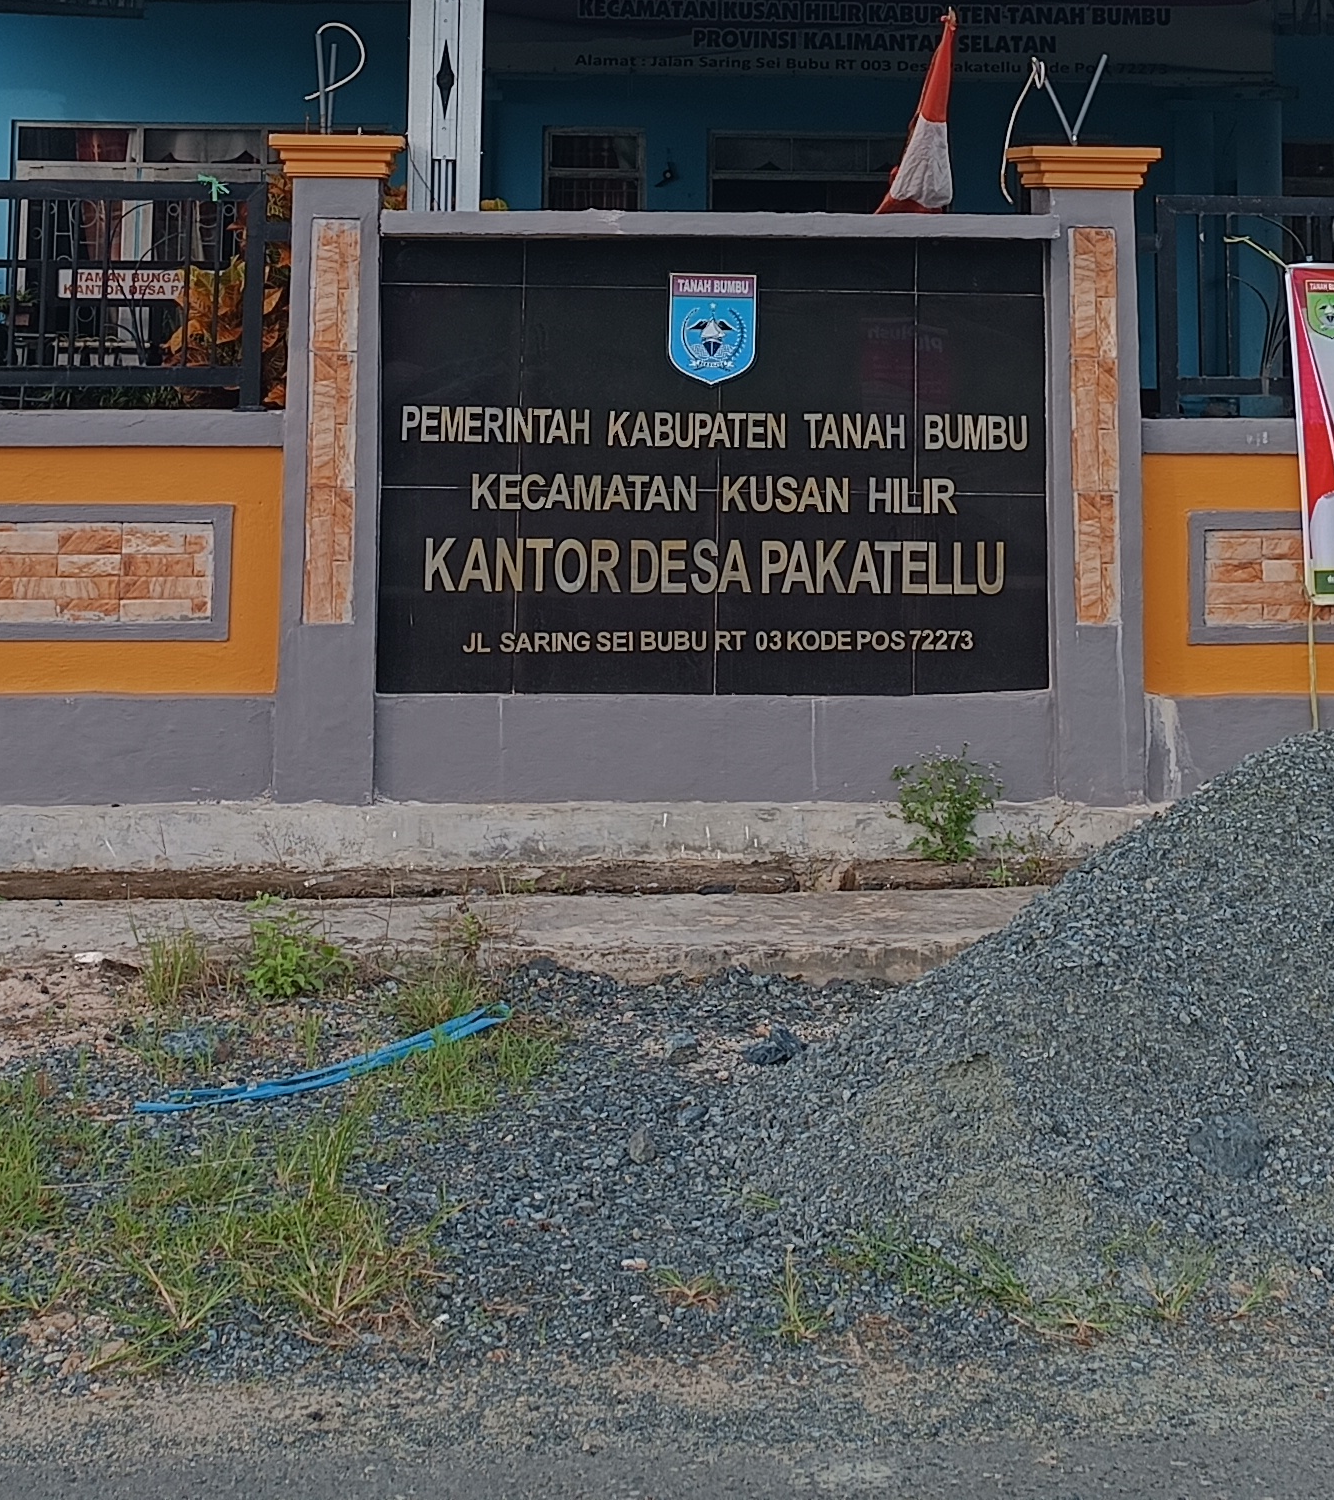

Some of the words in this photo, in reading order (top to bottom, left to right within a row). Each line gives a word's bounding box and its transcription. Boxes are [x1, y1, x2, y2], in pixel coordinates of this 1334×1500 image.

[721, 0, 803, 22] KUSAN
[803, 2, 865, 24] HILIR
[1008, 4, 1090, 25] TANAH
[1092, 5, 1172, 26] BUMBU
[691, 28, 798, 50] PROVINSI
[958, 34, 1057, 54] SELATAN
[575, 54, 637, 69] Alamat
[650, 55, 694, 69] Jalan
[698, 56, 752, 71] Saring
[755, 57, 782, 70] Sei
[787, 57, 831, 71] Bubu
[835, 59, 856, 71] RT
[860, 60, 893, 73] 003
[950, 60, 1021, 73] akatellu
[132, 272, 181, 283] BUNGA
[677, 278, 712, 294] TANAH
[714, 279, 749, 296] BUMBU
[129, 285, 166, 296] DESA
[401, 405, 590, 447] PEMERINTAH
[607, 409, 788, 450] KABUPATEN
[803, 412, 907, 450] TANAH
[924, 413, 1029, 452] BUMBU
[472, 472, 697, 514] KECAMATAN
[721, 474, 850, 514] KUSAN
[868, 476, 958, 515] HILIR
[424, 536, 622, 594] KANTOR
[629, 538, 749, 594] DESA
[760, 539, 1006, 596] PAKATELLU
[462, 632, 491, 654] JL
[499, 631, 591, 654] SARING
[595, 632, 635, 653] SEI
[639, 631, 707, 653] BUBU
[715, 631, 747, 653] RT
[755, 631, 783, 653] 03
[786, 631, 852, 653] KODE
[855, 631, 906, 653] POS
[909, 630, 974, 653] 72273
